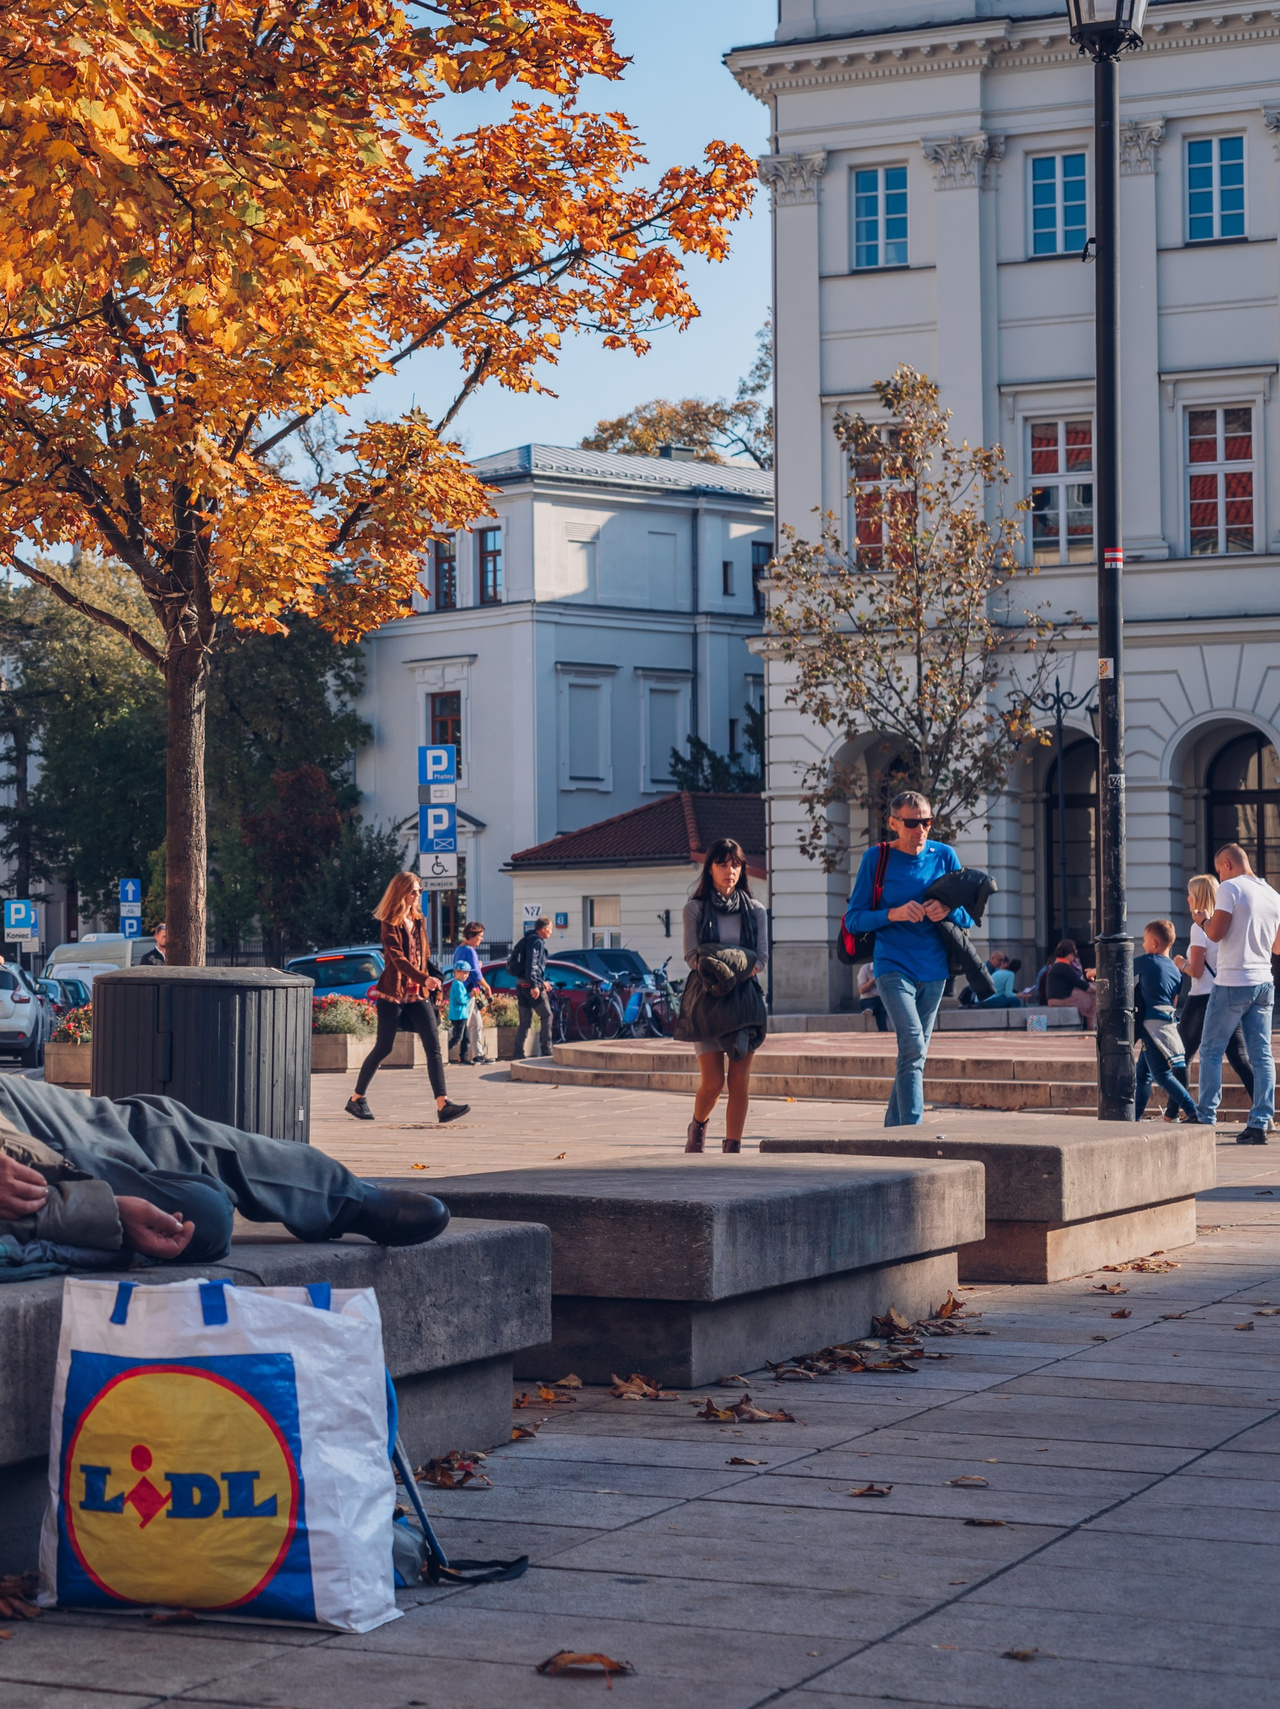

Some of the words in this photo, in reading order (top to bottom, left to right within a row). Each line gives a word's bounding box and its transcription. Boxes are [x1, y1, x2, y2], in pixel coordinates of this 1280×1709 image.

[426, 749, 448, 780] P
[427, 808, 449, 839] P
[11, 904, 26, 925] P
[524, 906, 541, 917] NFZ
[6, 931, 30, 939] Koniec
[125, 919, 137, 937] P
